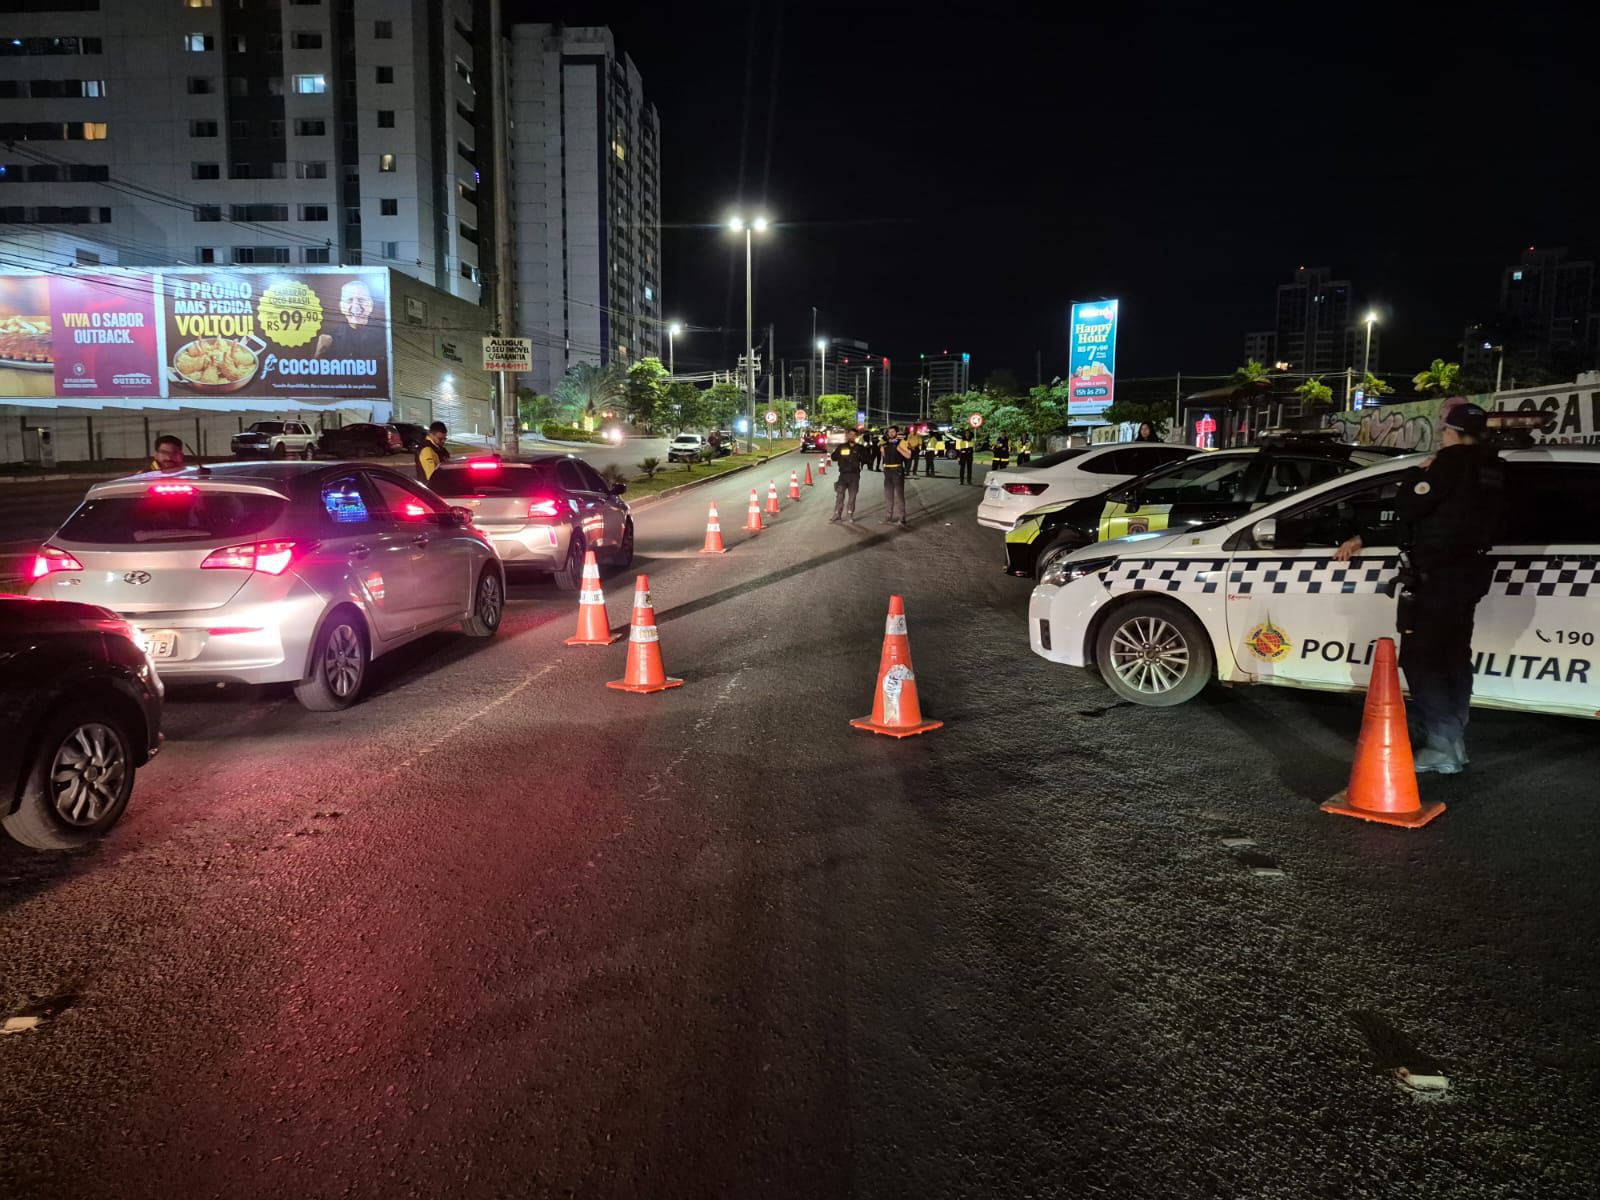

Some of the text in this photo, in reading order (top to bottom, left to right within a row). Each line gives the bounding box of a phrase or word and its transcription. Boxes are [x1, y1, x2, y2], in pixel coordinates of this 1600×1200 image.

[189, 282, 252, 299] PROMO
[175, 300, 253, 314] MAIS PEDIDA
[62, 313, 144, 328] VIVA O SABOR
[175, 315, 254, 336] VOLTOU!
[74, 329, 134, 344] OUTBACK.
[1075, 323, 1113, 336] Happy
[1078, 333, 1108, 344] Hour
[112, 377, 153, 385] OUTBACK
[1556, 630, 1595, 646] 190
